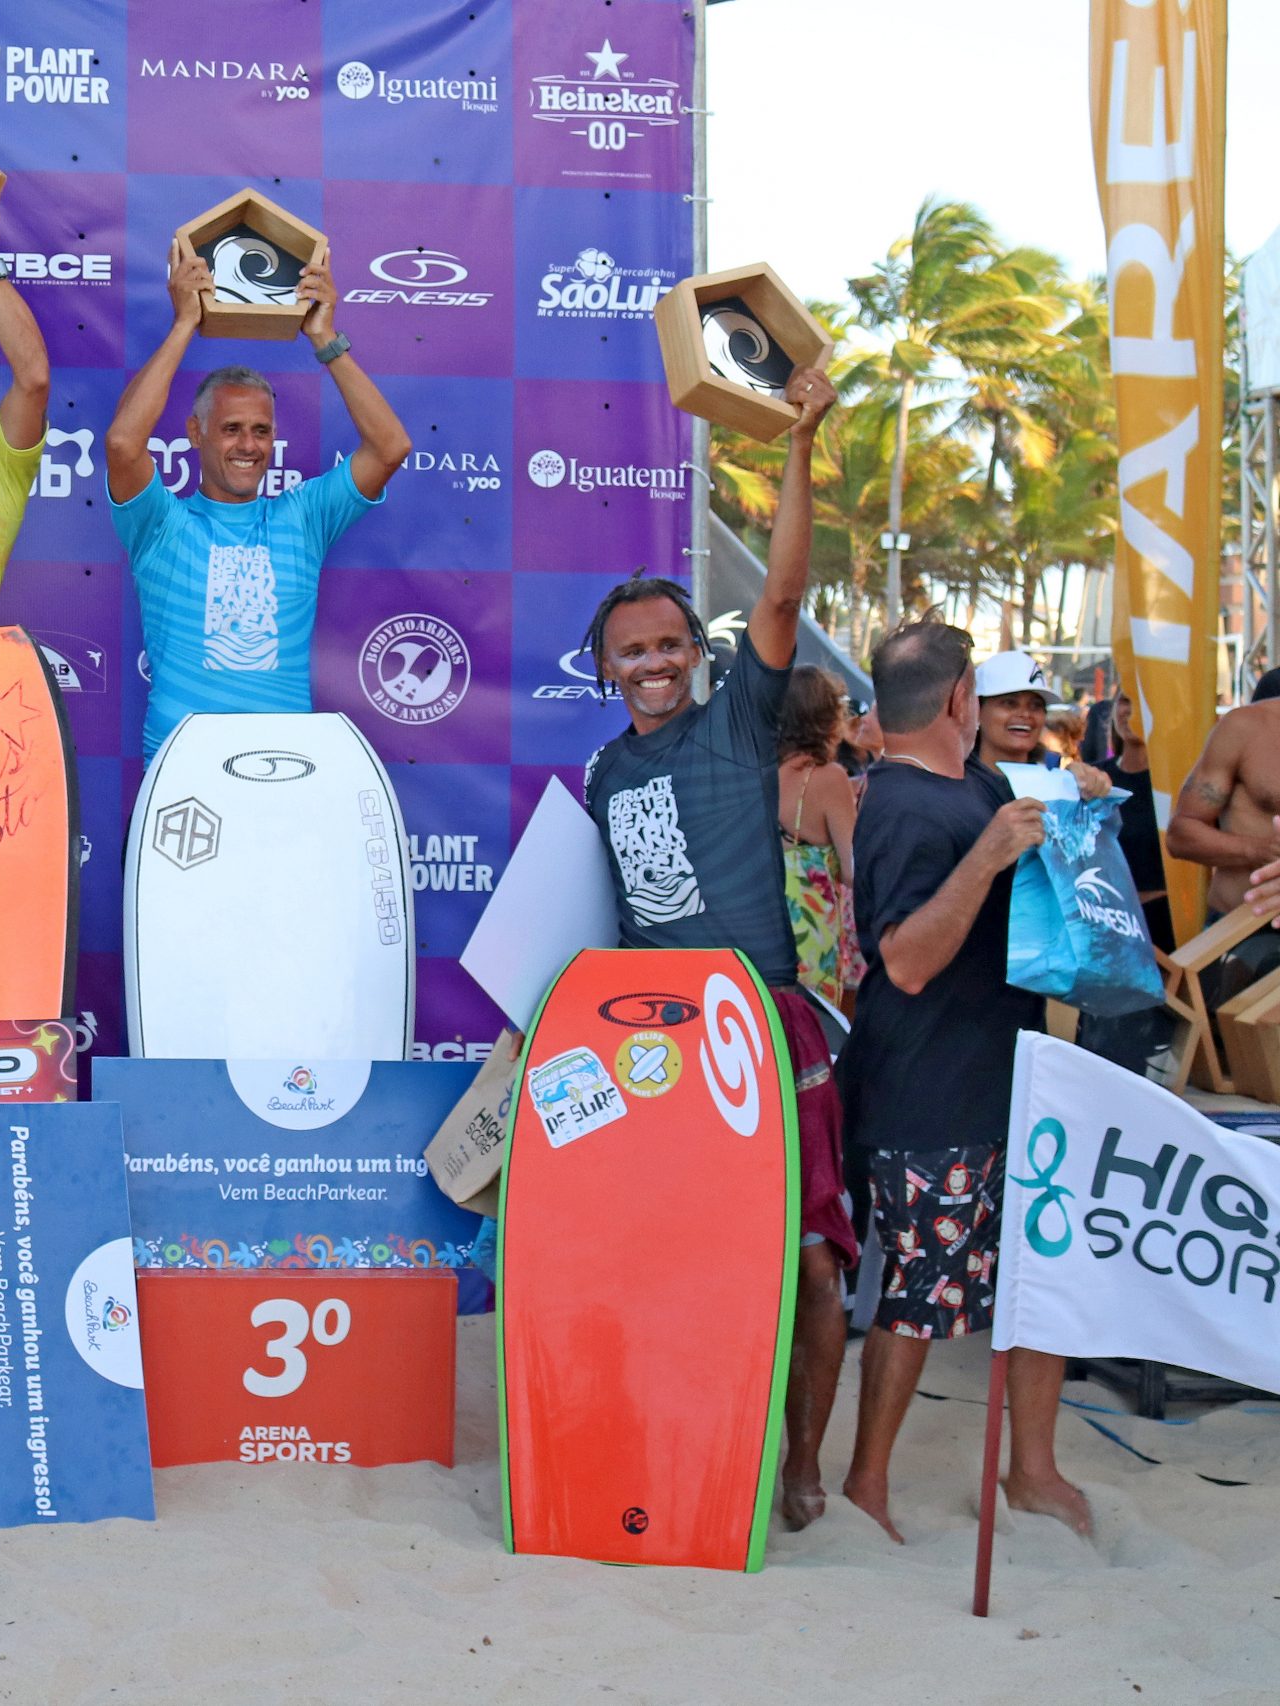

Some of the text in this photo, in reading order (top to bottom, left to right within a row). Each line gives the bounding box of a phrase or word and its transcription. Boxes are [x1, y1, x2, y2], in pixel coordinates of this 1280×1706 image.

[6, 47, 95, 75] PLANT
[140, 59, 310, 81] MANDARA
[6, 76, 110, 104] POWER
[276, 85, 310, 102] yoo
[378, 70, 498, 104] Iguatemi
[539, 86, 674, 115] Heineken
[462, 101, 498, 113] Bosque
[588, 121, 626, 150] 0.0
[548, 264, 676, 279] Super Mercadinhos
[343, 289, 494, 307] GENESIS
[537, 308, 553, 318] Me
[557, 310, 618, 319] acostumei
[622, 311, 644, 320] com
[467, 476, 501, 492] yoo
[569, 457, 686, 492] Iguatemi
[649, 488, 686, 501] Bosque
[365, 619, 465, 666] BODYBOARDERS
[372, 688, 458, 721] DAS ANTIGAS
[408, 836, 478, 862] LANT
[410, 864, 494, 892] OWER
[267, 1096, 336, 1113] BeachPark
[570, 1087, 618, 1124] SURF
[474, 1107, 507, 1147] HIGH
[223, 1153, 270, 1174] você
[274, 1153, 353, 1179] ganhou
[355, 1158, 392, 1174] um
[219, 1183, 388, 1202] Vem BeachParkear.
[1090, 1127, 1280, 1240] HIG
[10, 1125, 57, 1517] Parabéns, você ganhou um ingresso!
[83, 1279, 102, 1352] BeachPark
[239, 1426, 310, 1441] ARENA
[239, 1442, 352, 1463] SPORTS
